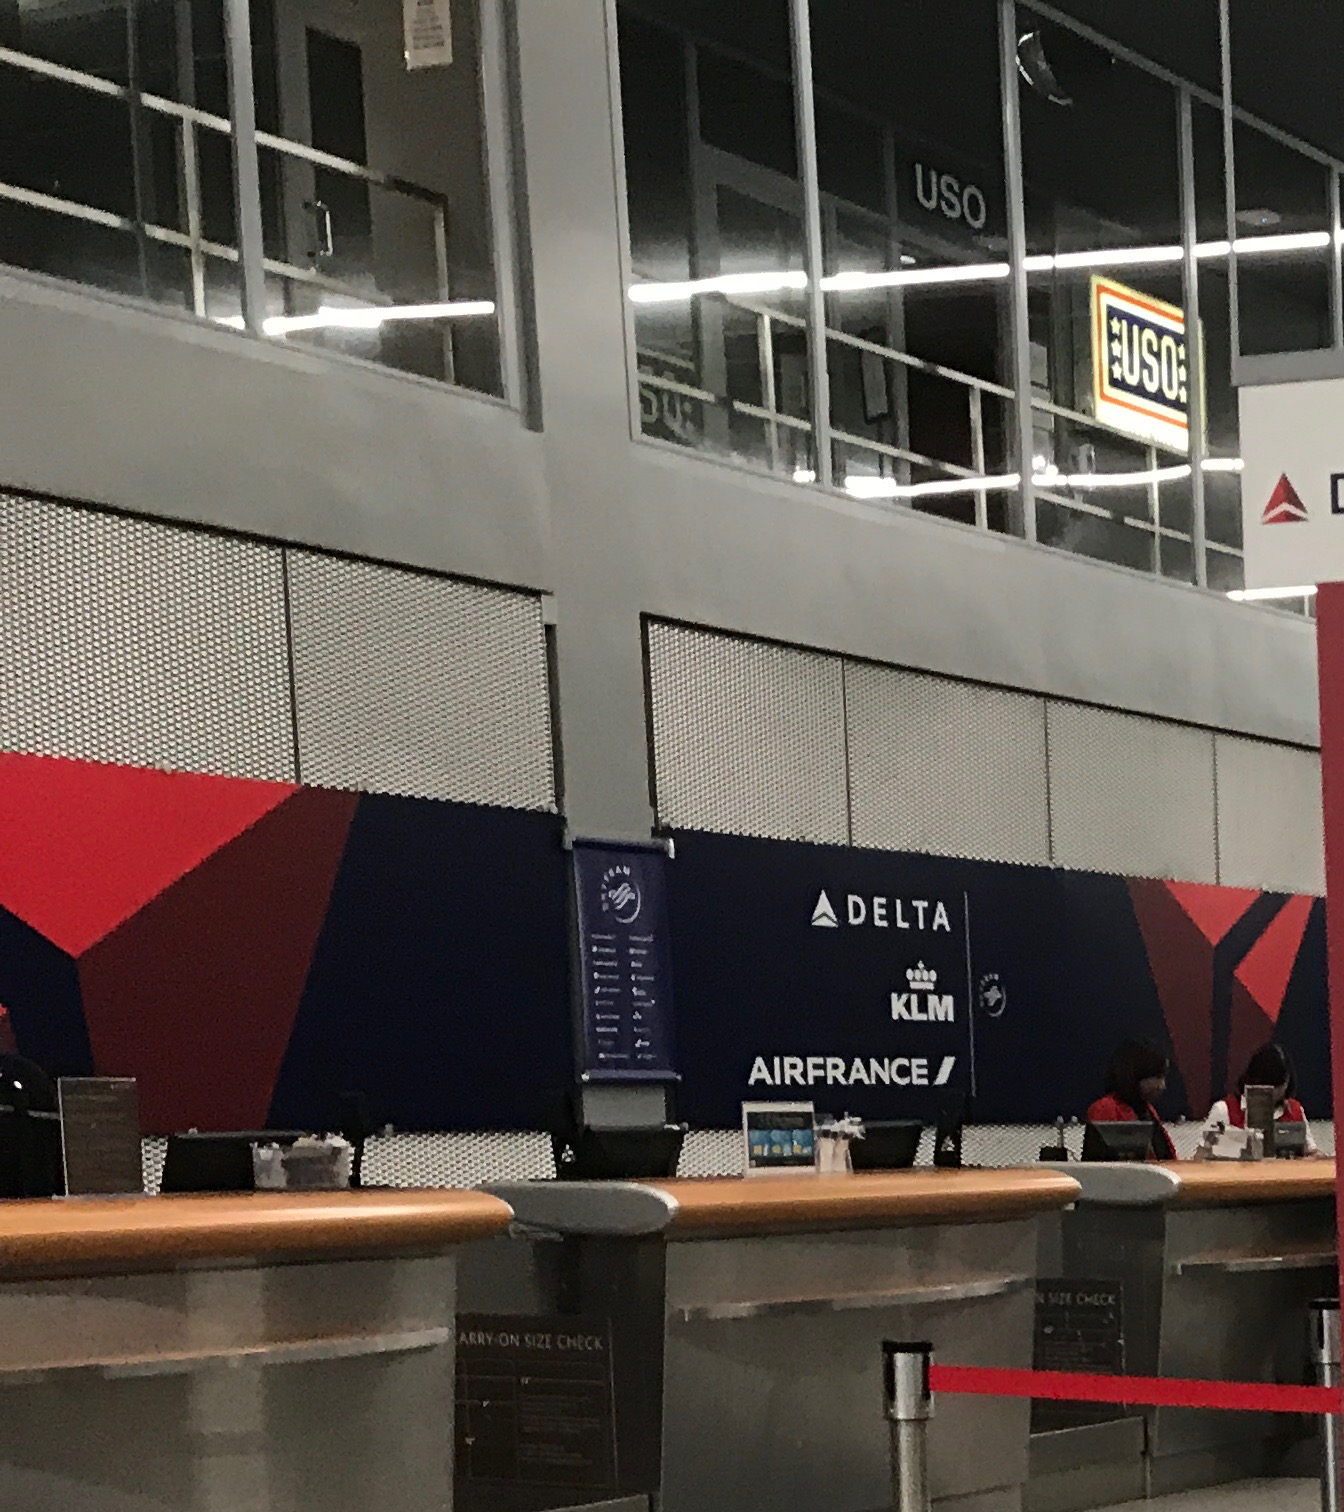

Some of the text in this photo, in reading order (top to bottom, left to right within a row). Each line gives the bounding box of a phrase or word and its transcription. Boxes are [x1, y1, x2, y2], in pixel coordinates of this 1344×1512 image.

[915, 162, 987, 229] USO
[1121, 319, 1178, 401] USO
[847, 894, 951, 932] DELTA
[890, 991, 955, 1022] KLM
[748, 1056, 930, 1086] AIRFRANCE
[459, 1330, 604, 1351] ARRY-ON SIZE CHECK
